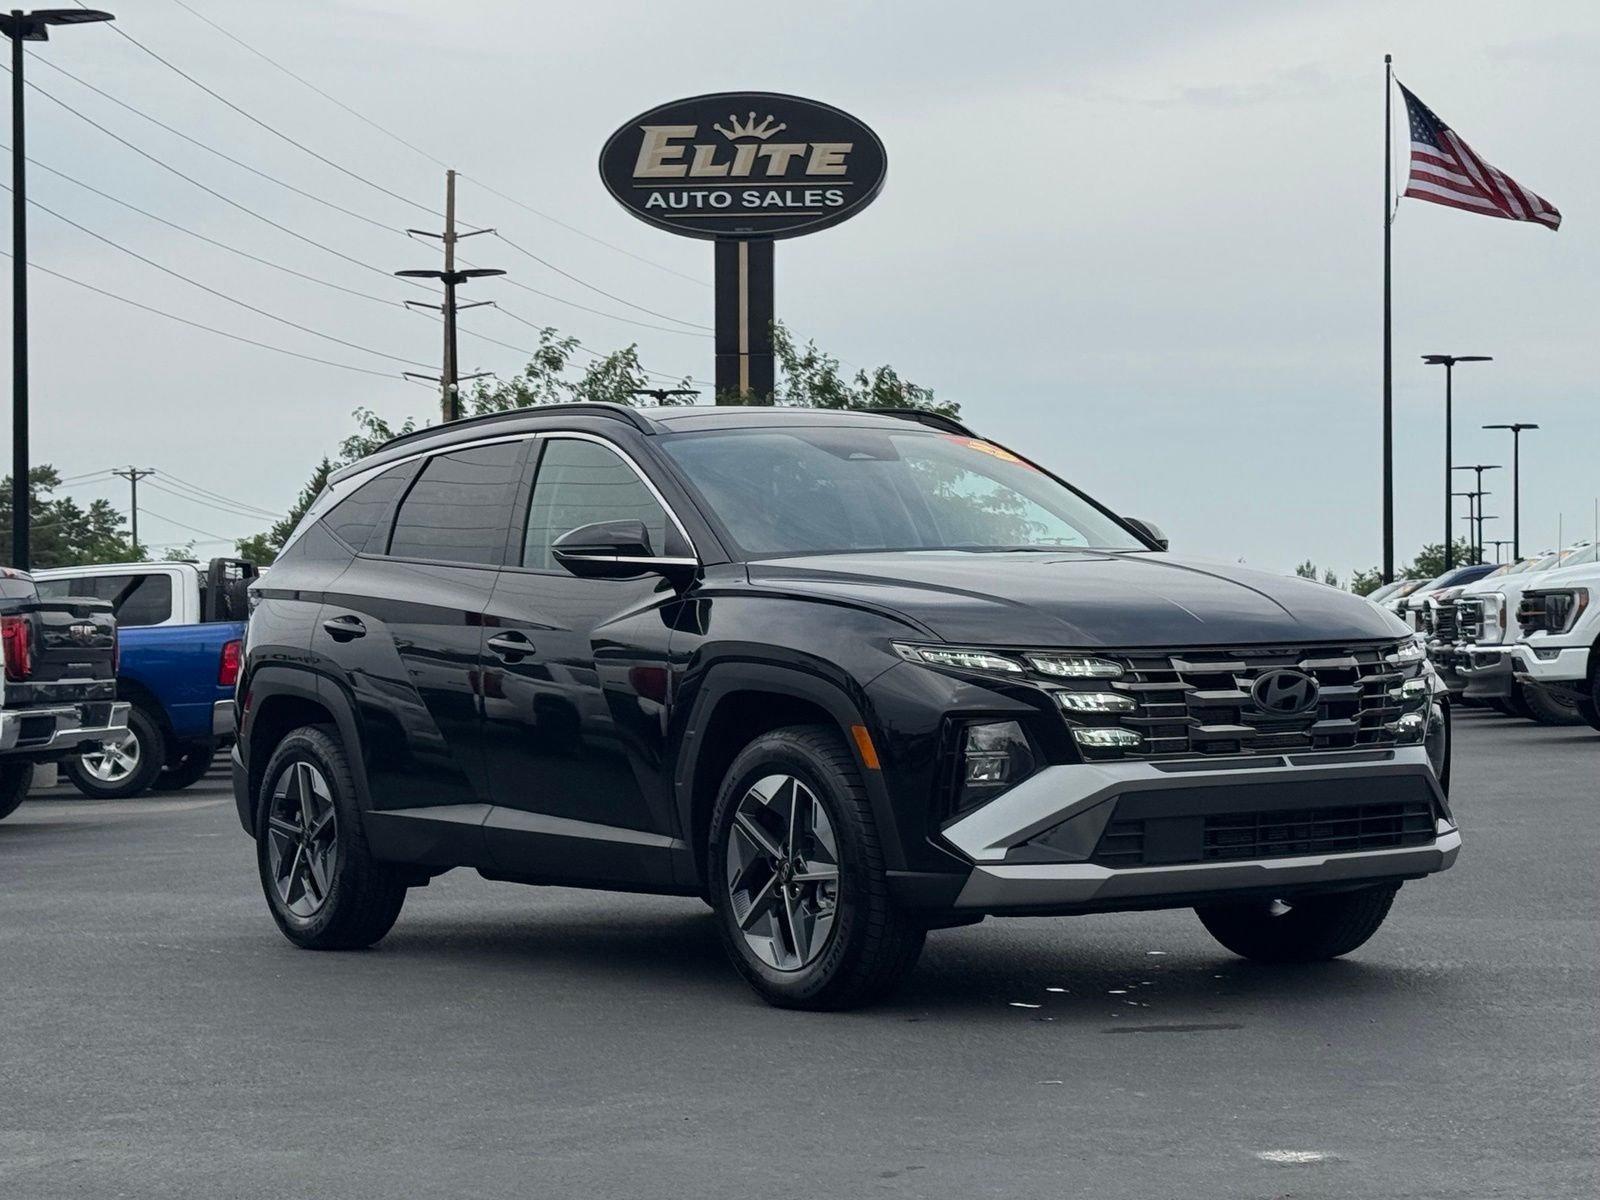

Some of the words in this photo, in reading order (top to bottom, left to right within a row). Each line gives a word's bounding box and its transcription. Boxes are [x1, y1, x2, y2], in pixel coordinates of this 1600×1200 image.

[632, 125, 853, 178] ELITE
[645, 191, 732, 209] AUTO
[741, 189, 844, 208] SALES
